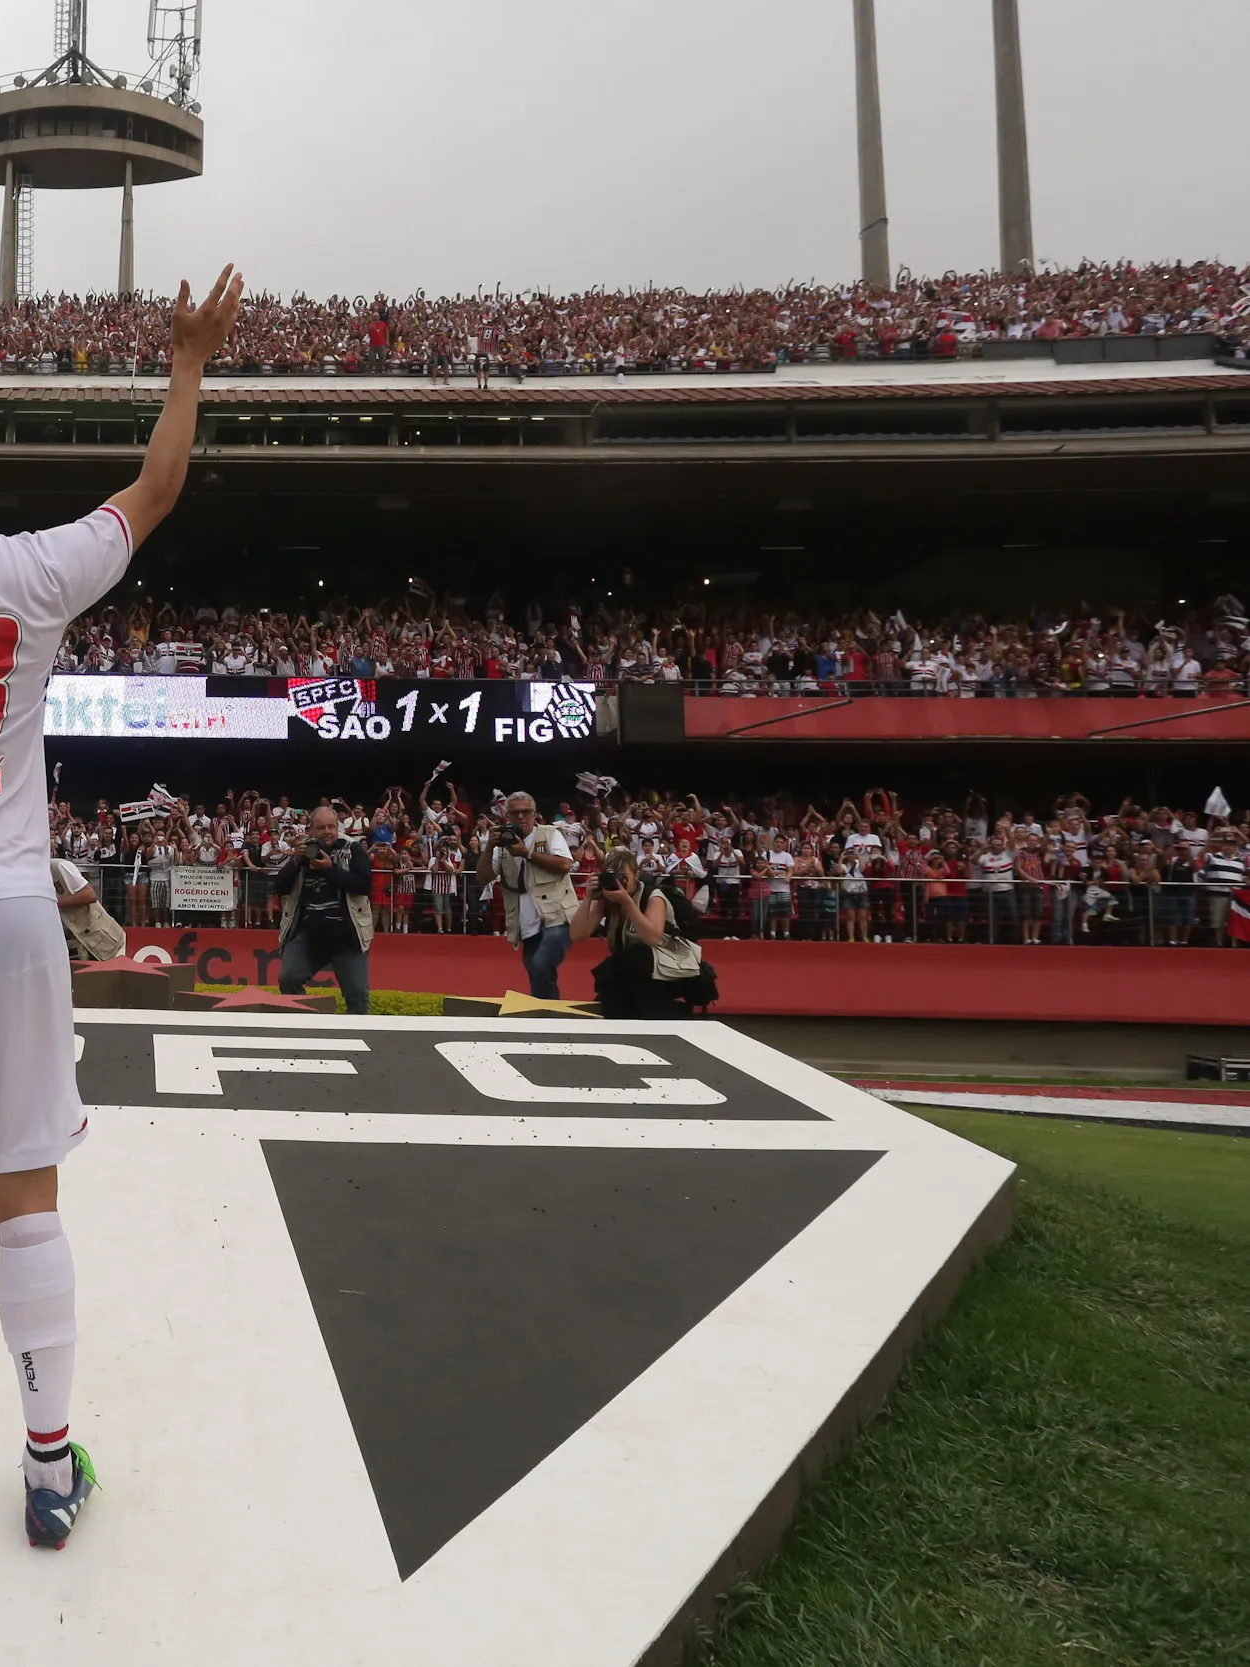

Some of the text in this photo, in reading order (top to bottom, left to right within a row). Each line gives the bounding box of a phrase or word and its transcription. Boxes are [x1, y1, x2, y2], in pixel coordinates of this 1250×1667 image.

[296, 680, 353, 706] SPFC
[396, 690, 419, 732] 1
[458, 691, 482, 733] 1
[495, 717, 554, 743] FIG
[174, 887, 209, 895] ROGÉRIO
